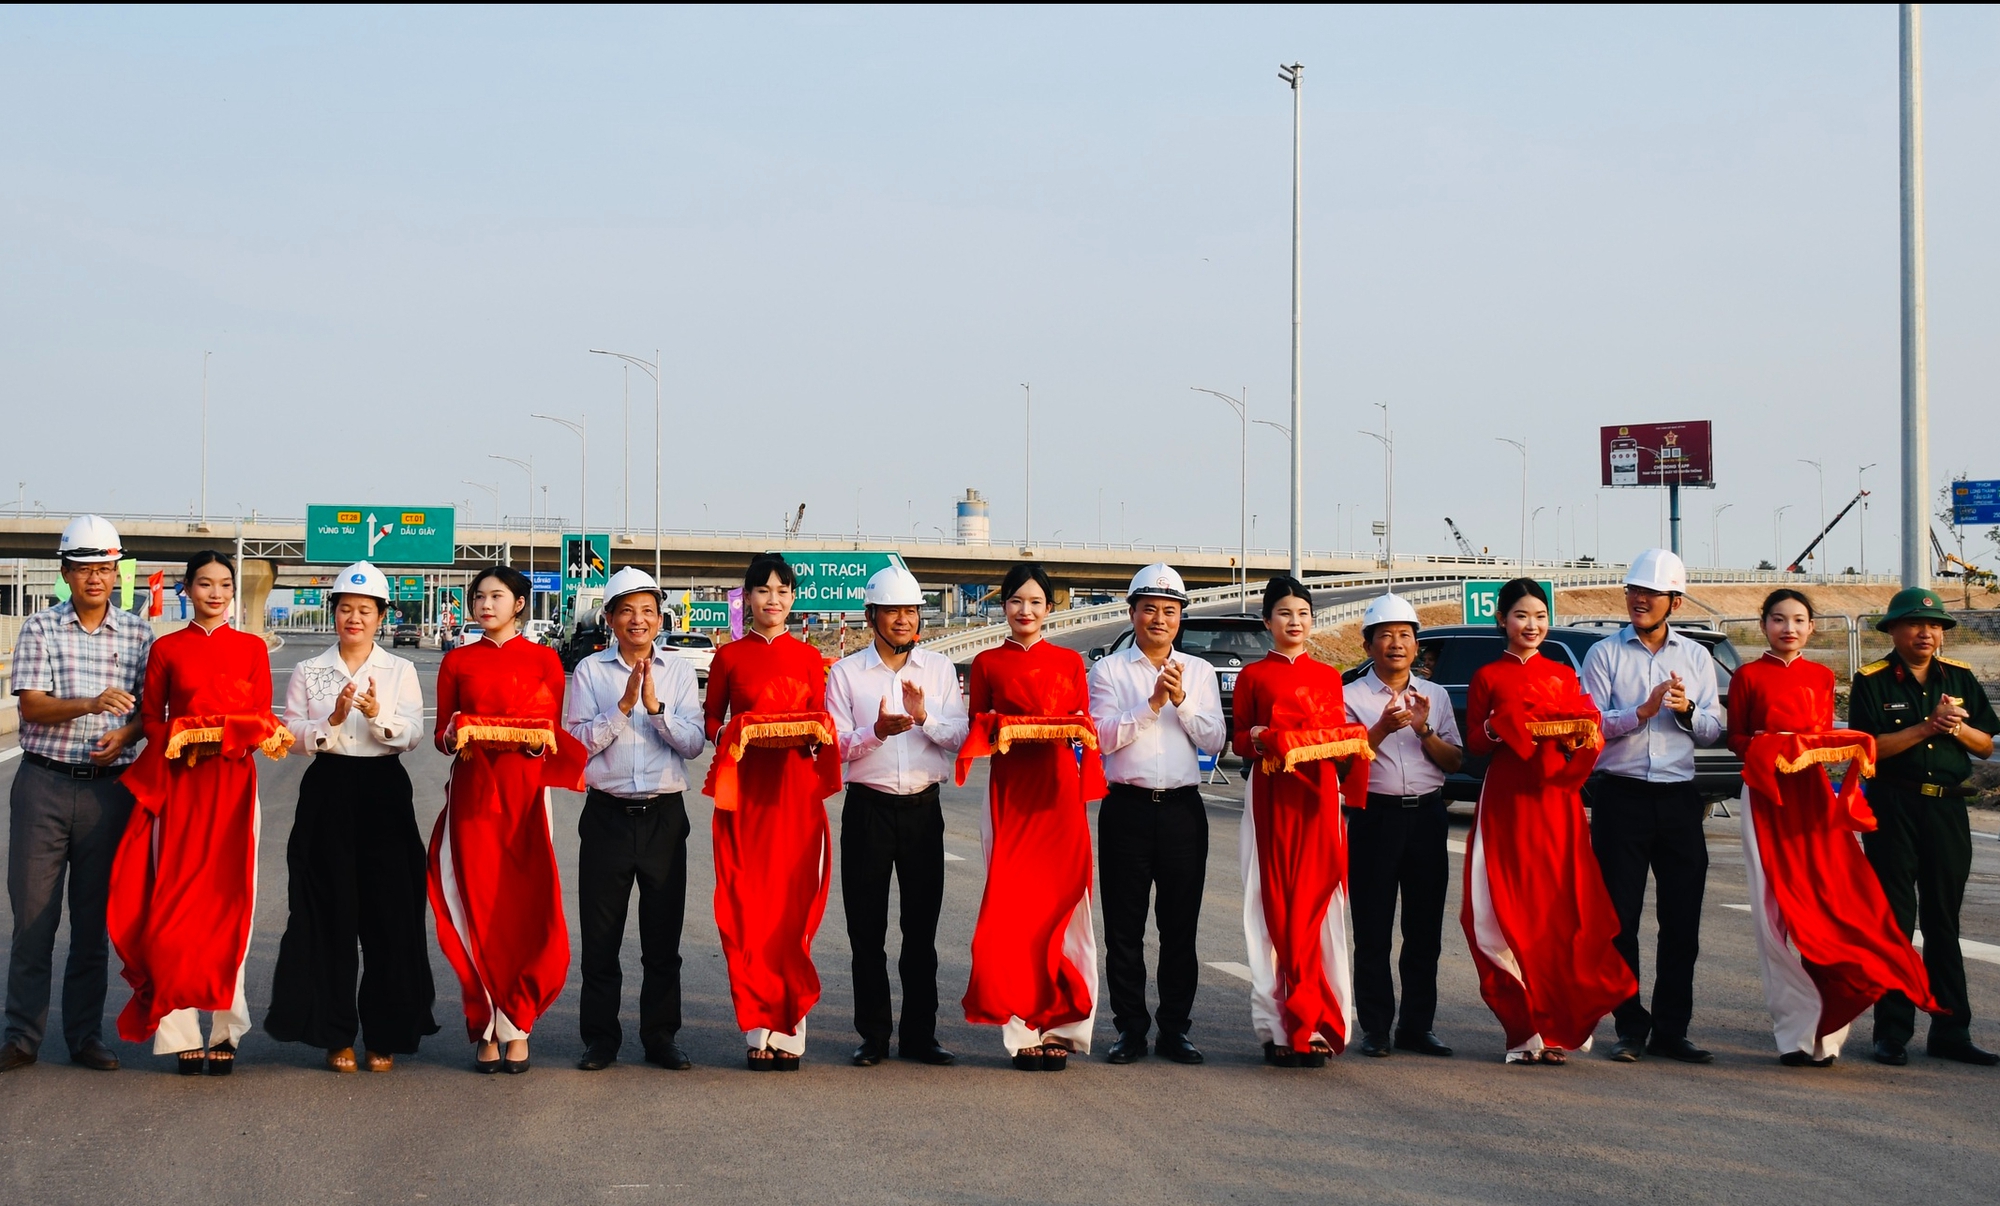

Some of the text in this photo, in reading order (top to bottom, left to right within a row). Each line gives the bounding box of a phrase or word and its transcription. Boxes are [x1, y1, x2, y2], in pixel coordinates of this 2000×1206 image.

[819, 563, 867, 579] TRẠCH
[820, 582, 843, 600] CHÍ
[846, 586, 867, 600] MIN
[1470, 592, 1501, 617] 15
